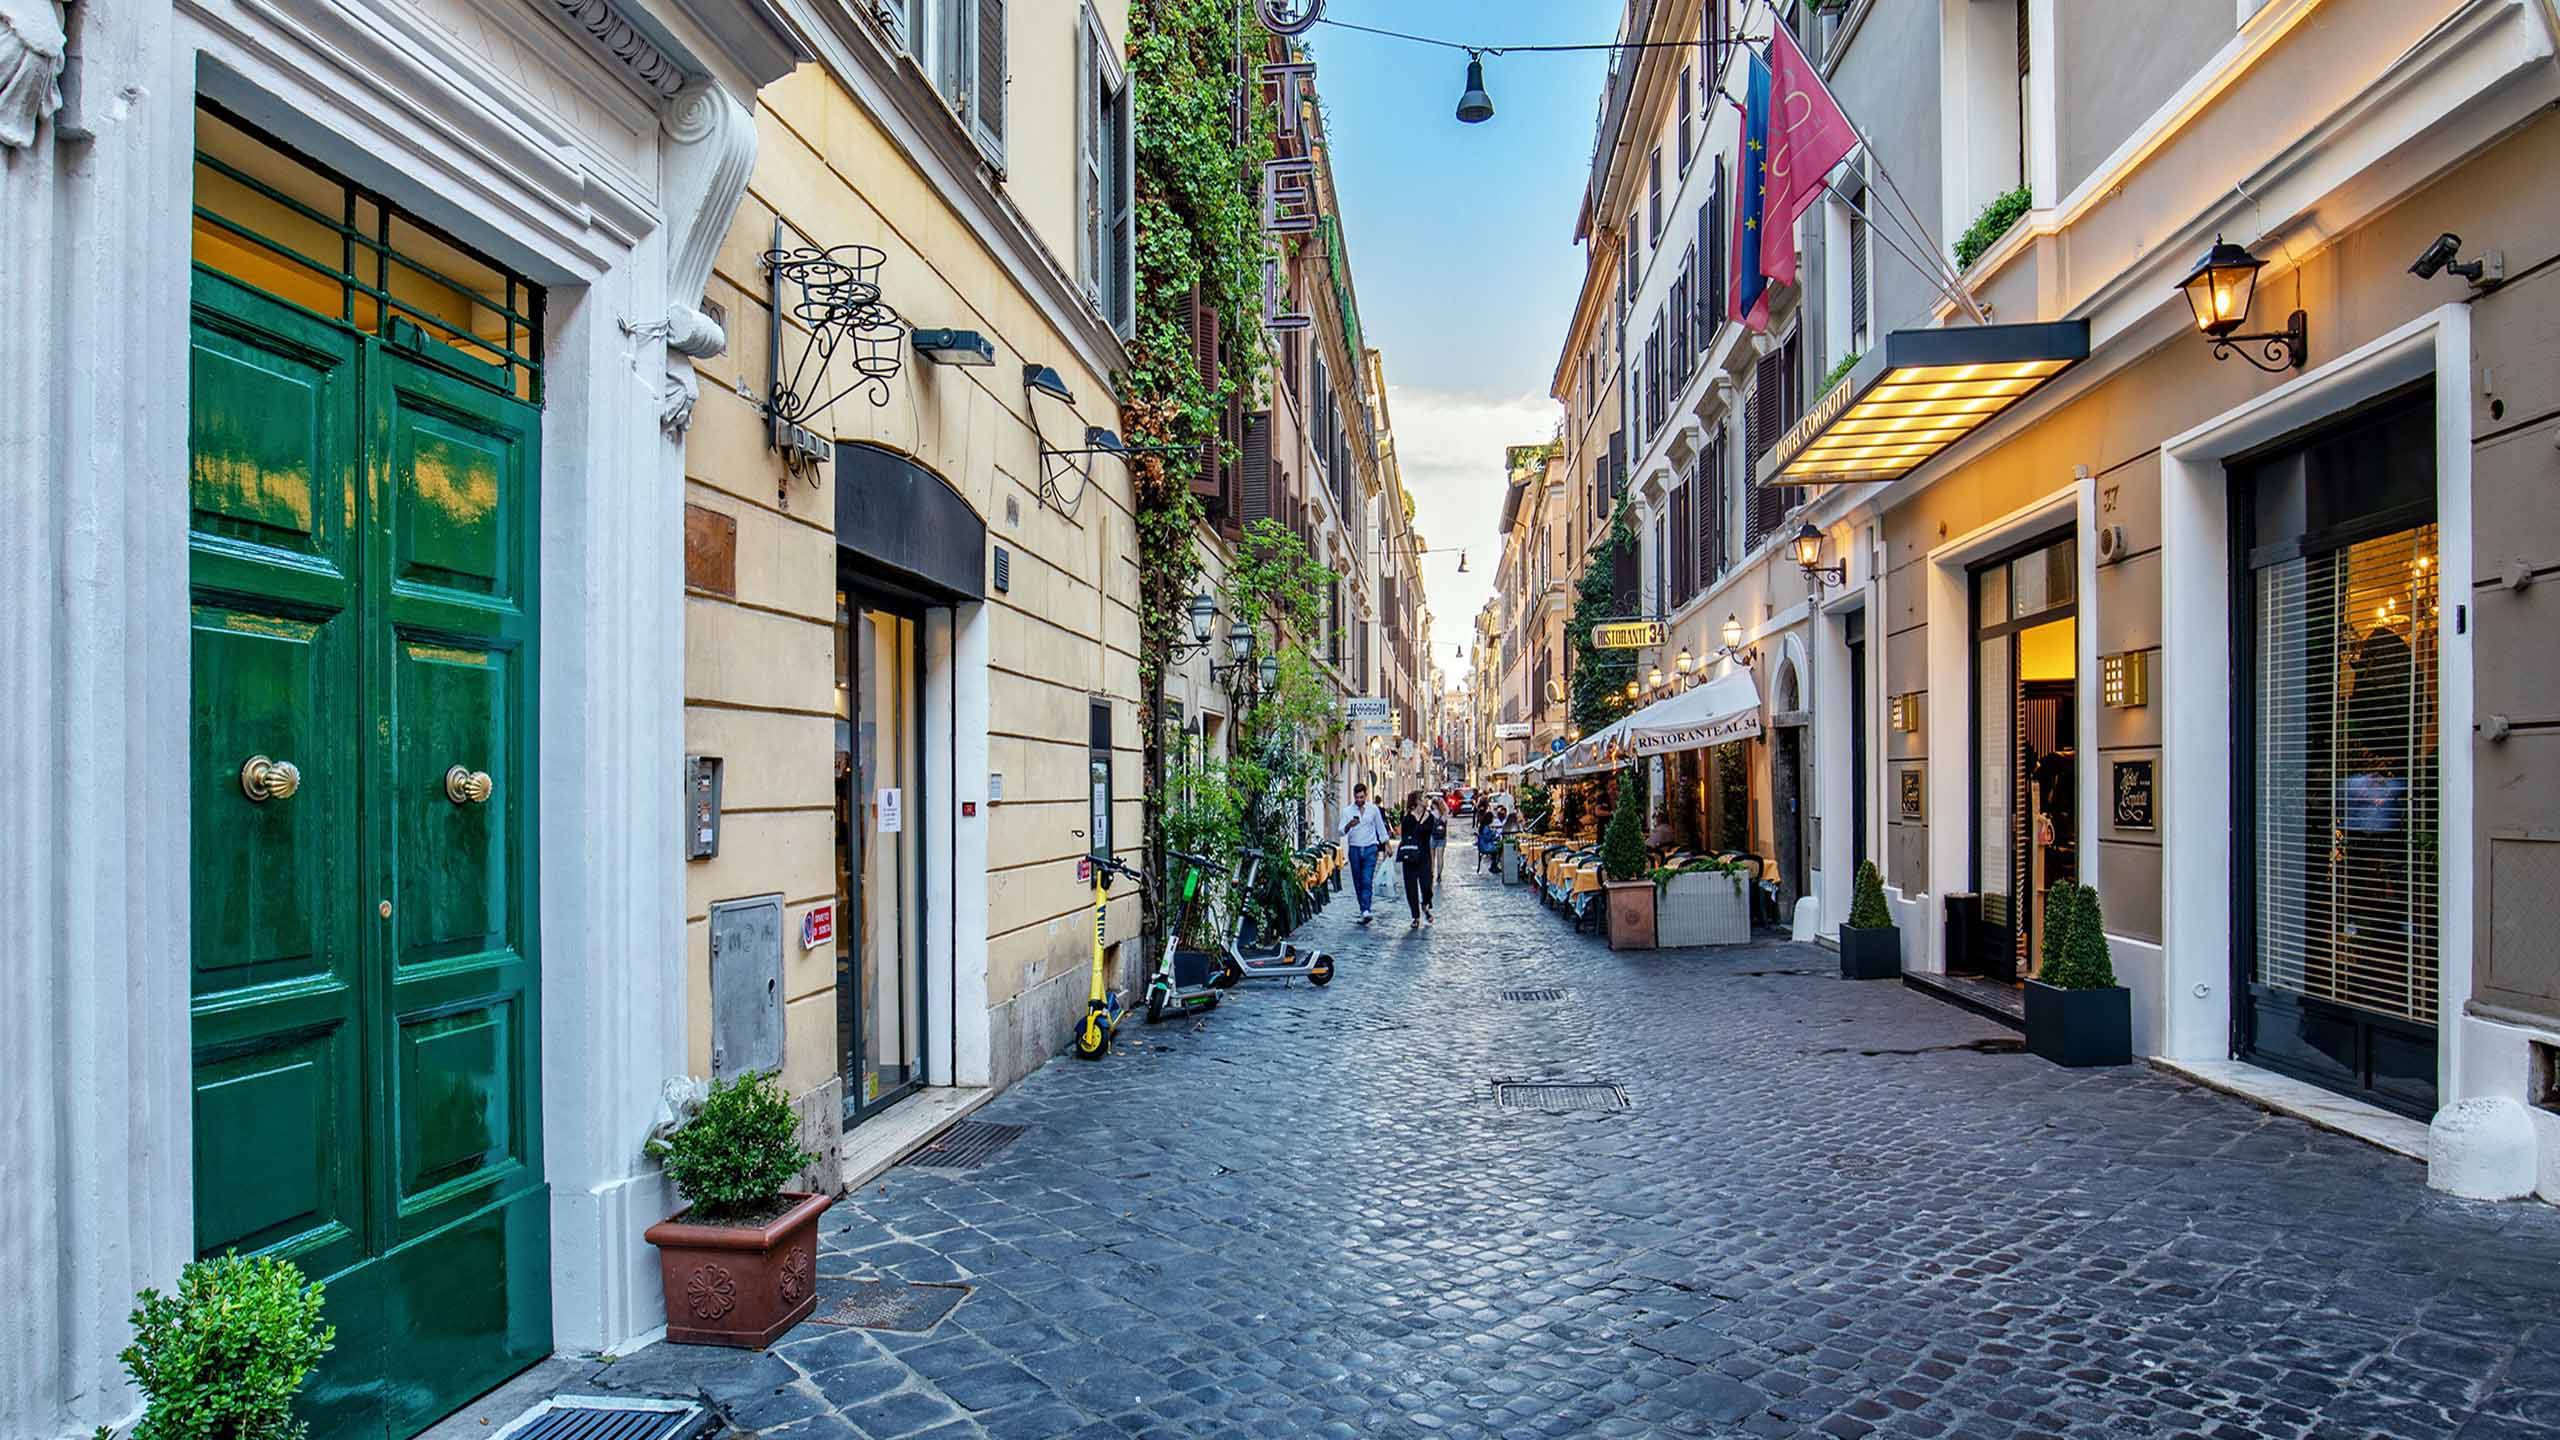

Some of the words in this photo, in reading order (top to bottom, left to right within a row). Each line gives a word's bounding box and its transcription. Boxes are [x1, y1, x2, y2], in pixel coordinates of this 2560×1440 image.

[1776, 427, 1801, 465] HOTEL
[1802, 378, 1852, 439] CONDOTTI
[2103, 484, 2120, 513] 37
[1597, 628, 1646, 646] RISTORANTE
[1649, 623, 1666, 643] 34
[1638, 727, 1722, 748] RISTORANTE
[1724, 721, 1742, 735] AL
[1744, 717, 1757, 730] 34
